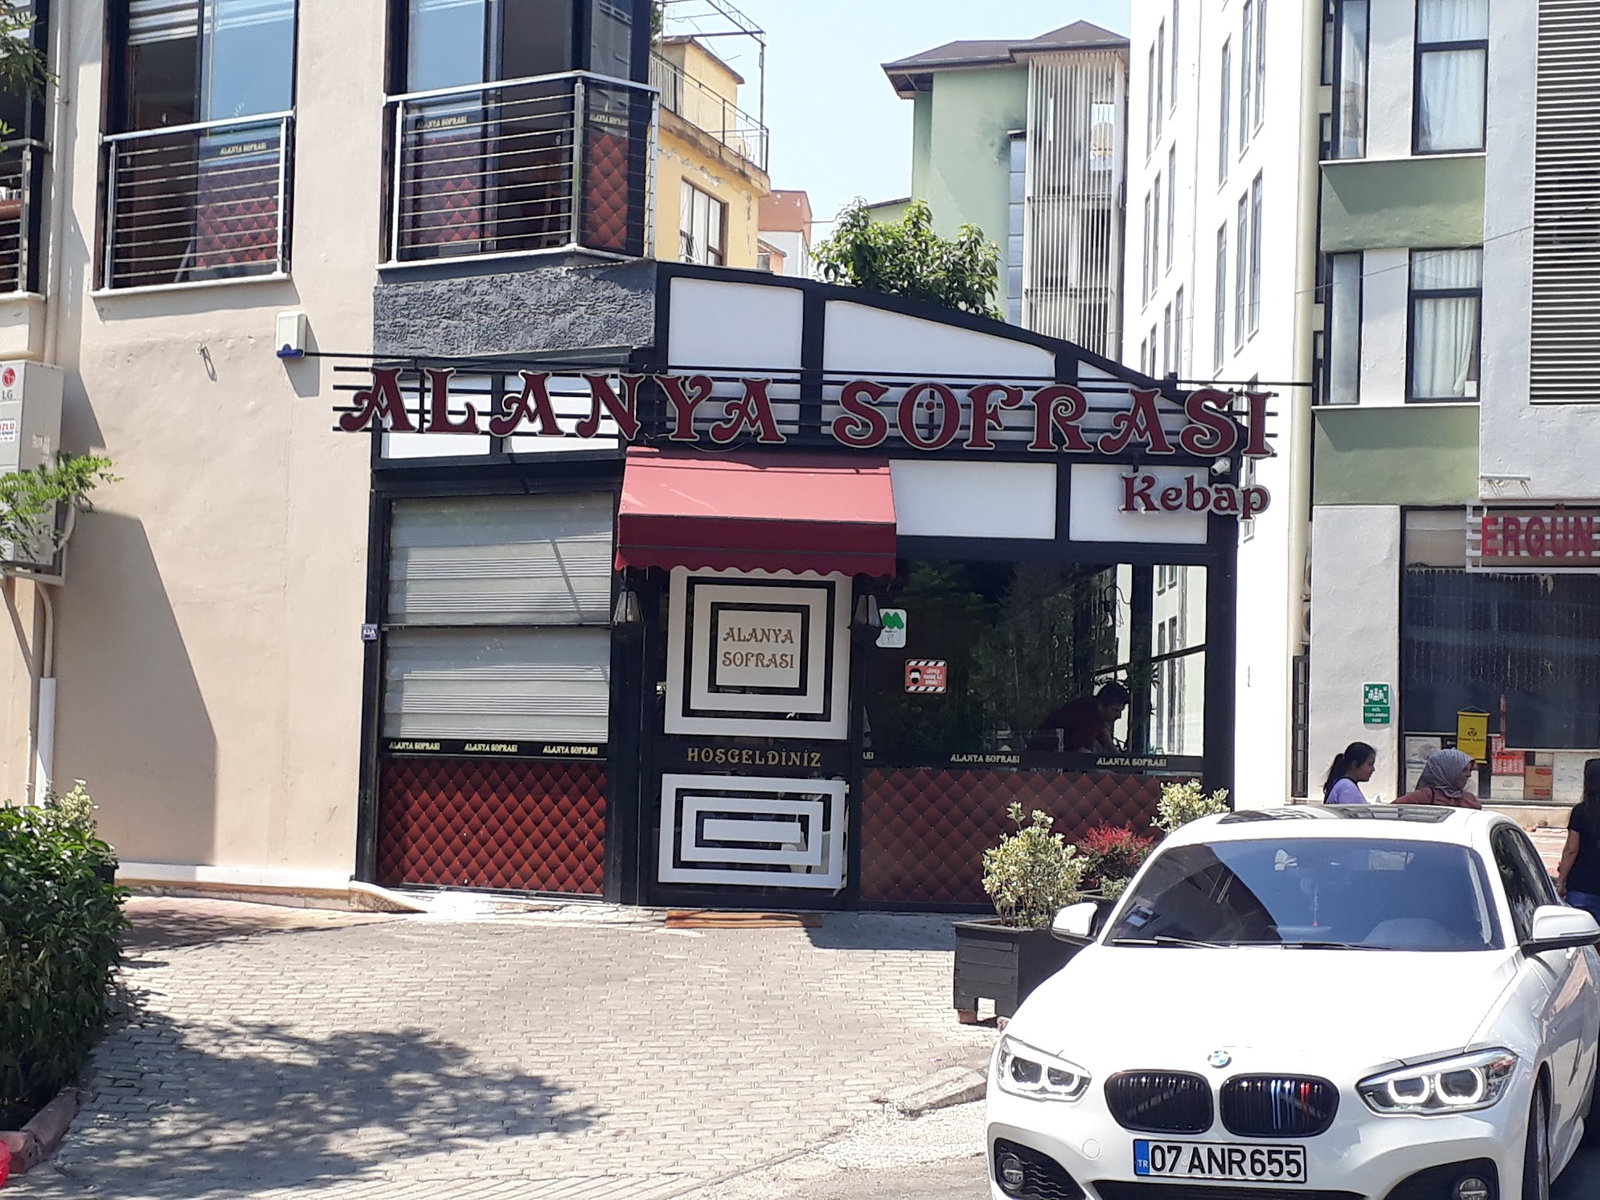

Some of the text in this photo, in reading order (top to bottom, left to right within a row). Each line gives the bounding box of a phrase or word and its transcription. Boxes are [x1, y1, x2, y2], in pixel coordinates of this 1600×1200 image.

[2, 389, 13, 400] LG
[338, 366, 1273, 458] ALANYA SOFRASI
[1119, 473, 1271, 522] Kebap
[722, 626, 795, 644] ALANYA
[721, 651, 795, 669] SOFRASI
[950, 754, 1020, 763] ALANYA SOFRASI
[1096, 757, 1130, 766] ALANYA
[1137, 1145, 1302, 1177] TR 07 ANR 655
